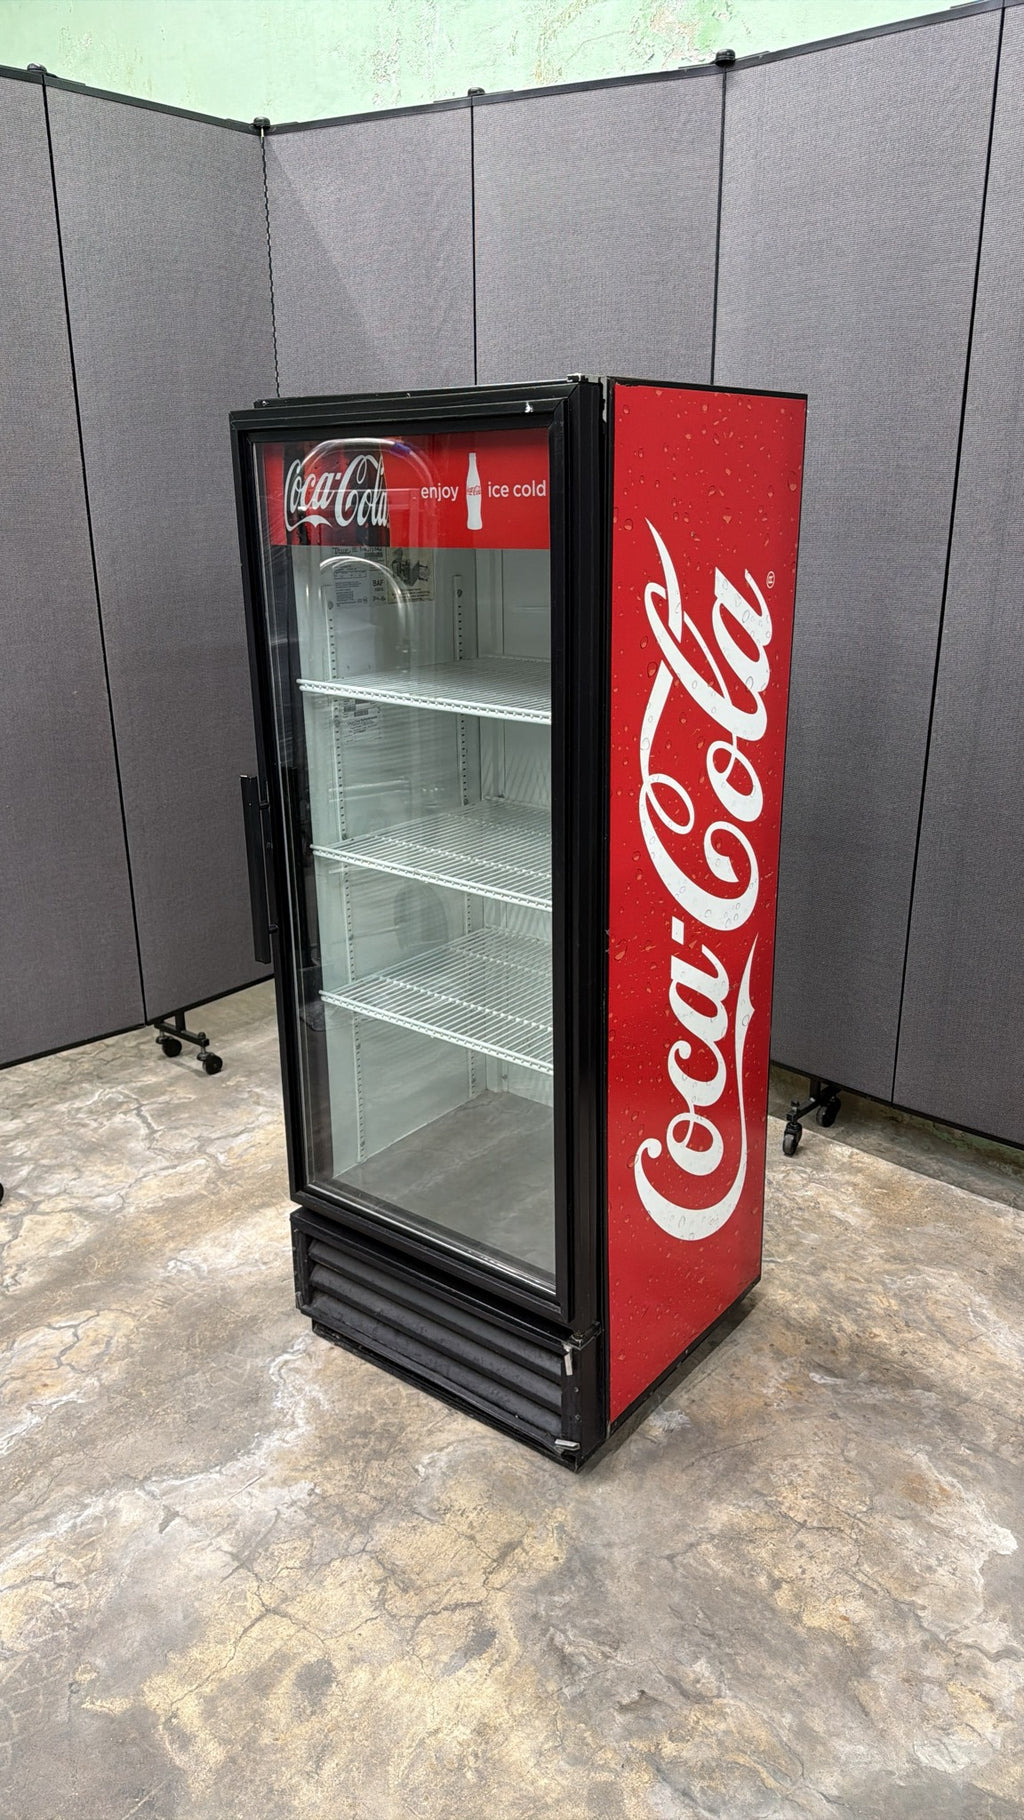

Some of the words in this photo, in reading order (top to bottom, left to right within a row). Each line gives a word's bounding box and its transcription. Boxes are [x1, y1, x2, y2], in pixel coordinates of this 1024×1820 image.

[420, 483, 459, 502] enjoy
[487, 481, 509, 498] ice
[512, 479, 547, 498] cold
